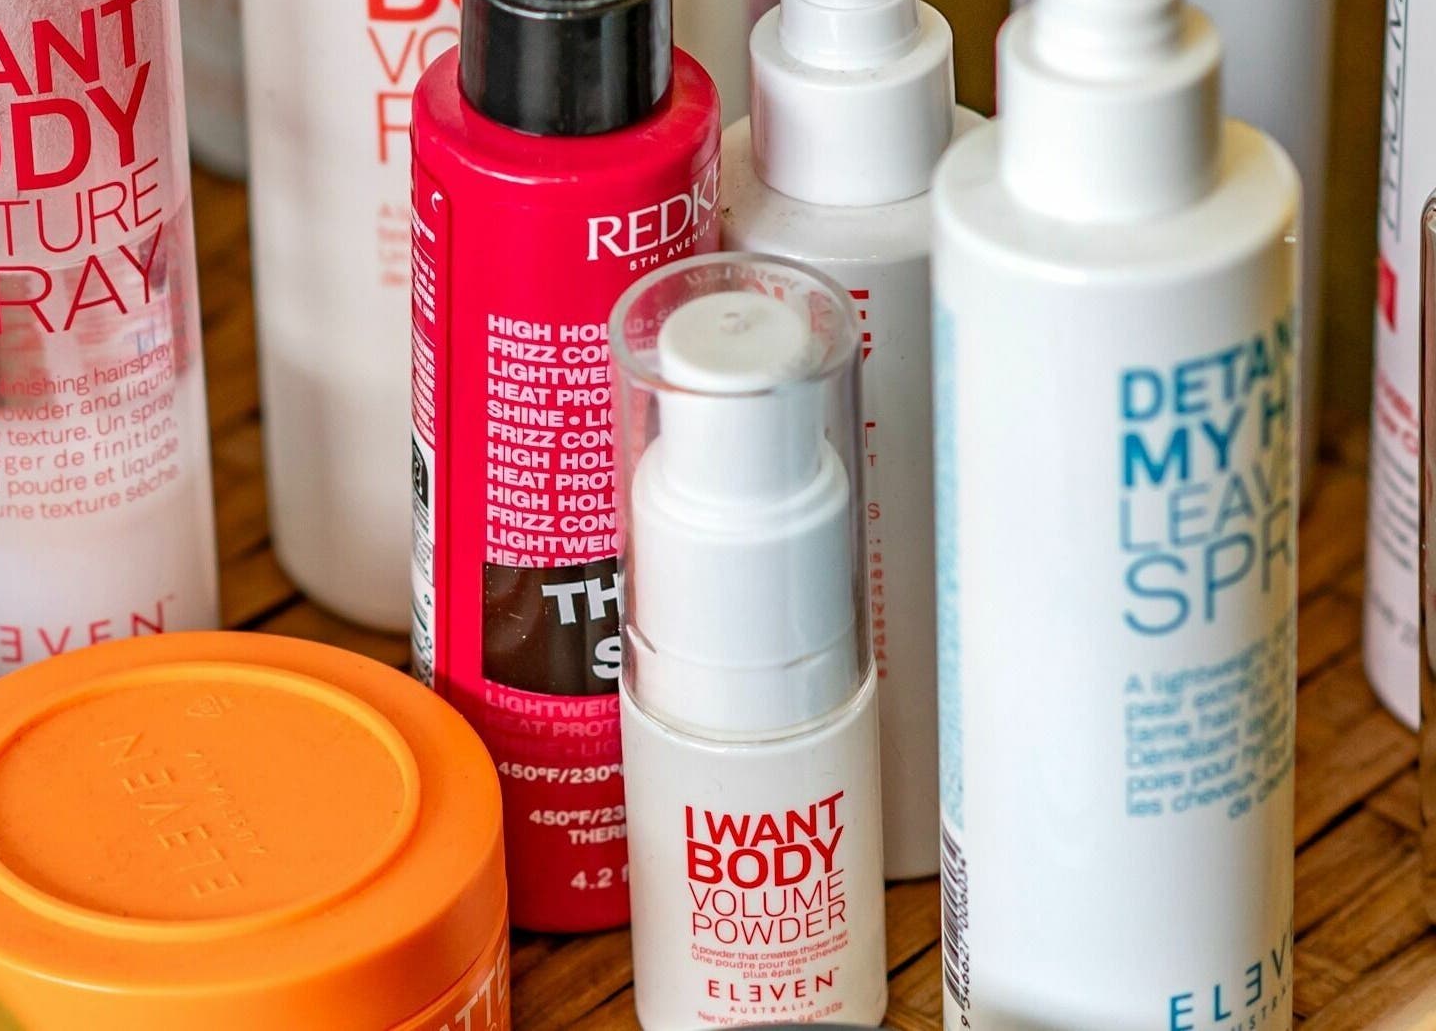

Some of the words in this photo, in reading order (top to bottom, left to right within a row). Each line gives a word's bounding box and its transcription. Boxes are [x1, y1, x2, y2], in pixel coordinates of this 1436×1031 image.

[629, 253, 660, 272] 5TH
[488, 314, 552, 342] HIGH
[94, 340, 173, 387] hairspray
[488, 336, 557, 365] FRIZZ
[80, 386, 122, 416] and
[488, 380, 556, 406] HEAT
[7, 424, 93, 448] texture.
[95, 414, 127, 437] Un
[130, 386, 176, 426] spray
[487, 401, 565, 428] SHINE
[487, 421, 556, 449] FRIZZ
[1121, 404, 1247, 488] MY
[53, 448, 86, 469] de
[487, 442, 551, 470] HIGH
[6, 472, 88, 499] poudre
[94, 466, 116, 489] et
[487, 465, 551, 492] HEAT
[39, 490, 122, 520] texture
[487, 485, 550, 512] HIGH
[487, 507, 555, 533] FRIZZ
[684, 804, 694, 840] I
[703, 789, 845, 848] WANT
[686, 824, 845, 890] BODY
[570, 866, 613, 892] 4.2
[688, 868, 845, 919] VOLUME
[692, 899, 847, 946] POWDER
[690, 942, 699, 952] A
[699, 946, 736, 960] powder
[738, 951, 759, 962] that
[761, 948, 799, 962] creates
[799, 938, 831, 956] thicker
[832, 929, 848, 946] hair
[690, 951, 714, 966] Une
[715, 956, 756, 971] poudre
[758, 960, 785, 972] pour
[787, 955, 808, 968] des
[809, 938, 849, 963] cheveux
[742, 969, 769, 981] plus
[728, 999, 815, 1016] AUSTRALIA
